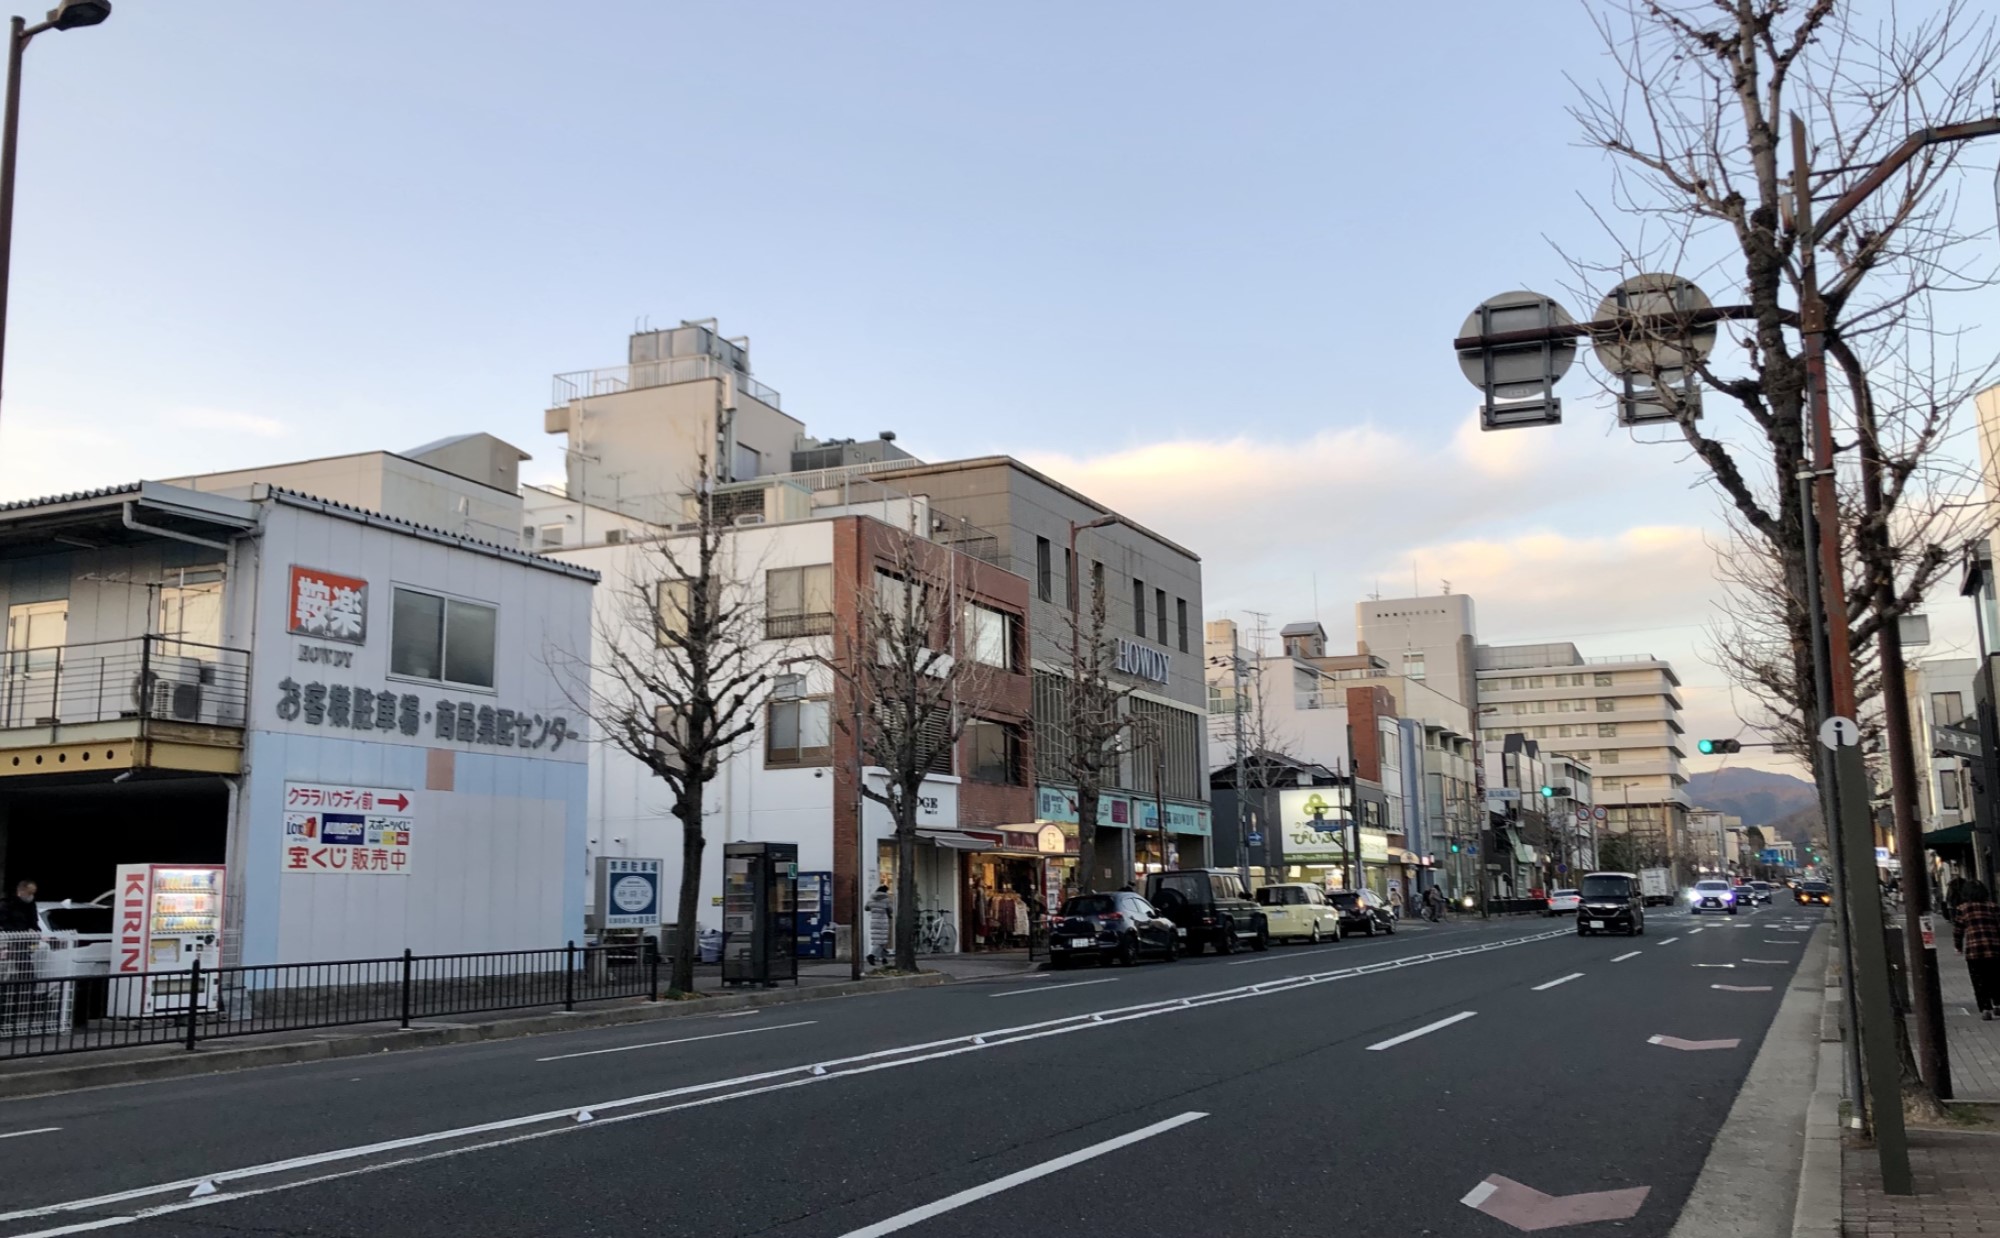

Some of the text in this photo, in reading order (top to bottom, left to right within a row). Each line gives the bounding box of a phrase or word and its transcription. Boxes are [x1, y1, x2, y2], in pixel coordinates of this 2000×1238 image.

[1115, 637, 1173, 685] HOWDY
[1935, 730, 1977, 751] トキヤ
[288, 786, 374, 811] クララハウディ前
[367, 817, 412, 831] スポーツくじ
[287, 846, 406, 871] 宝くじ 販売中
[120, 873, 145, 972] KIRIN
